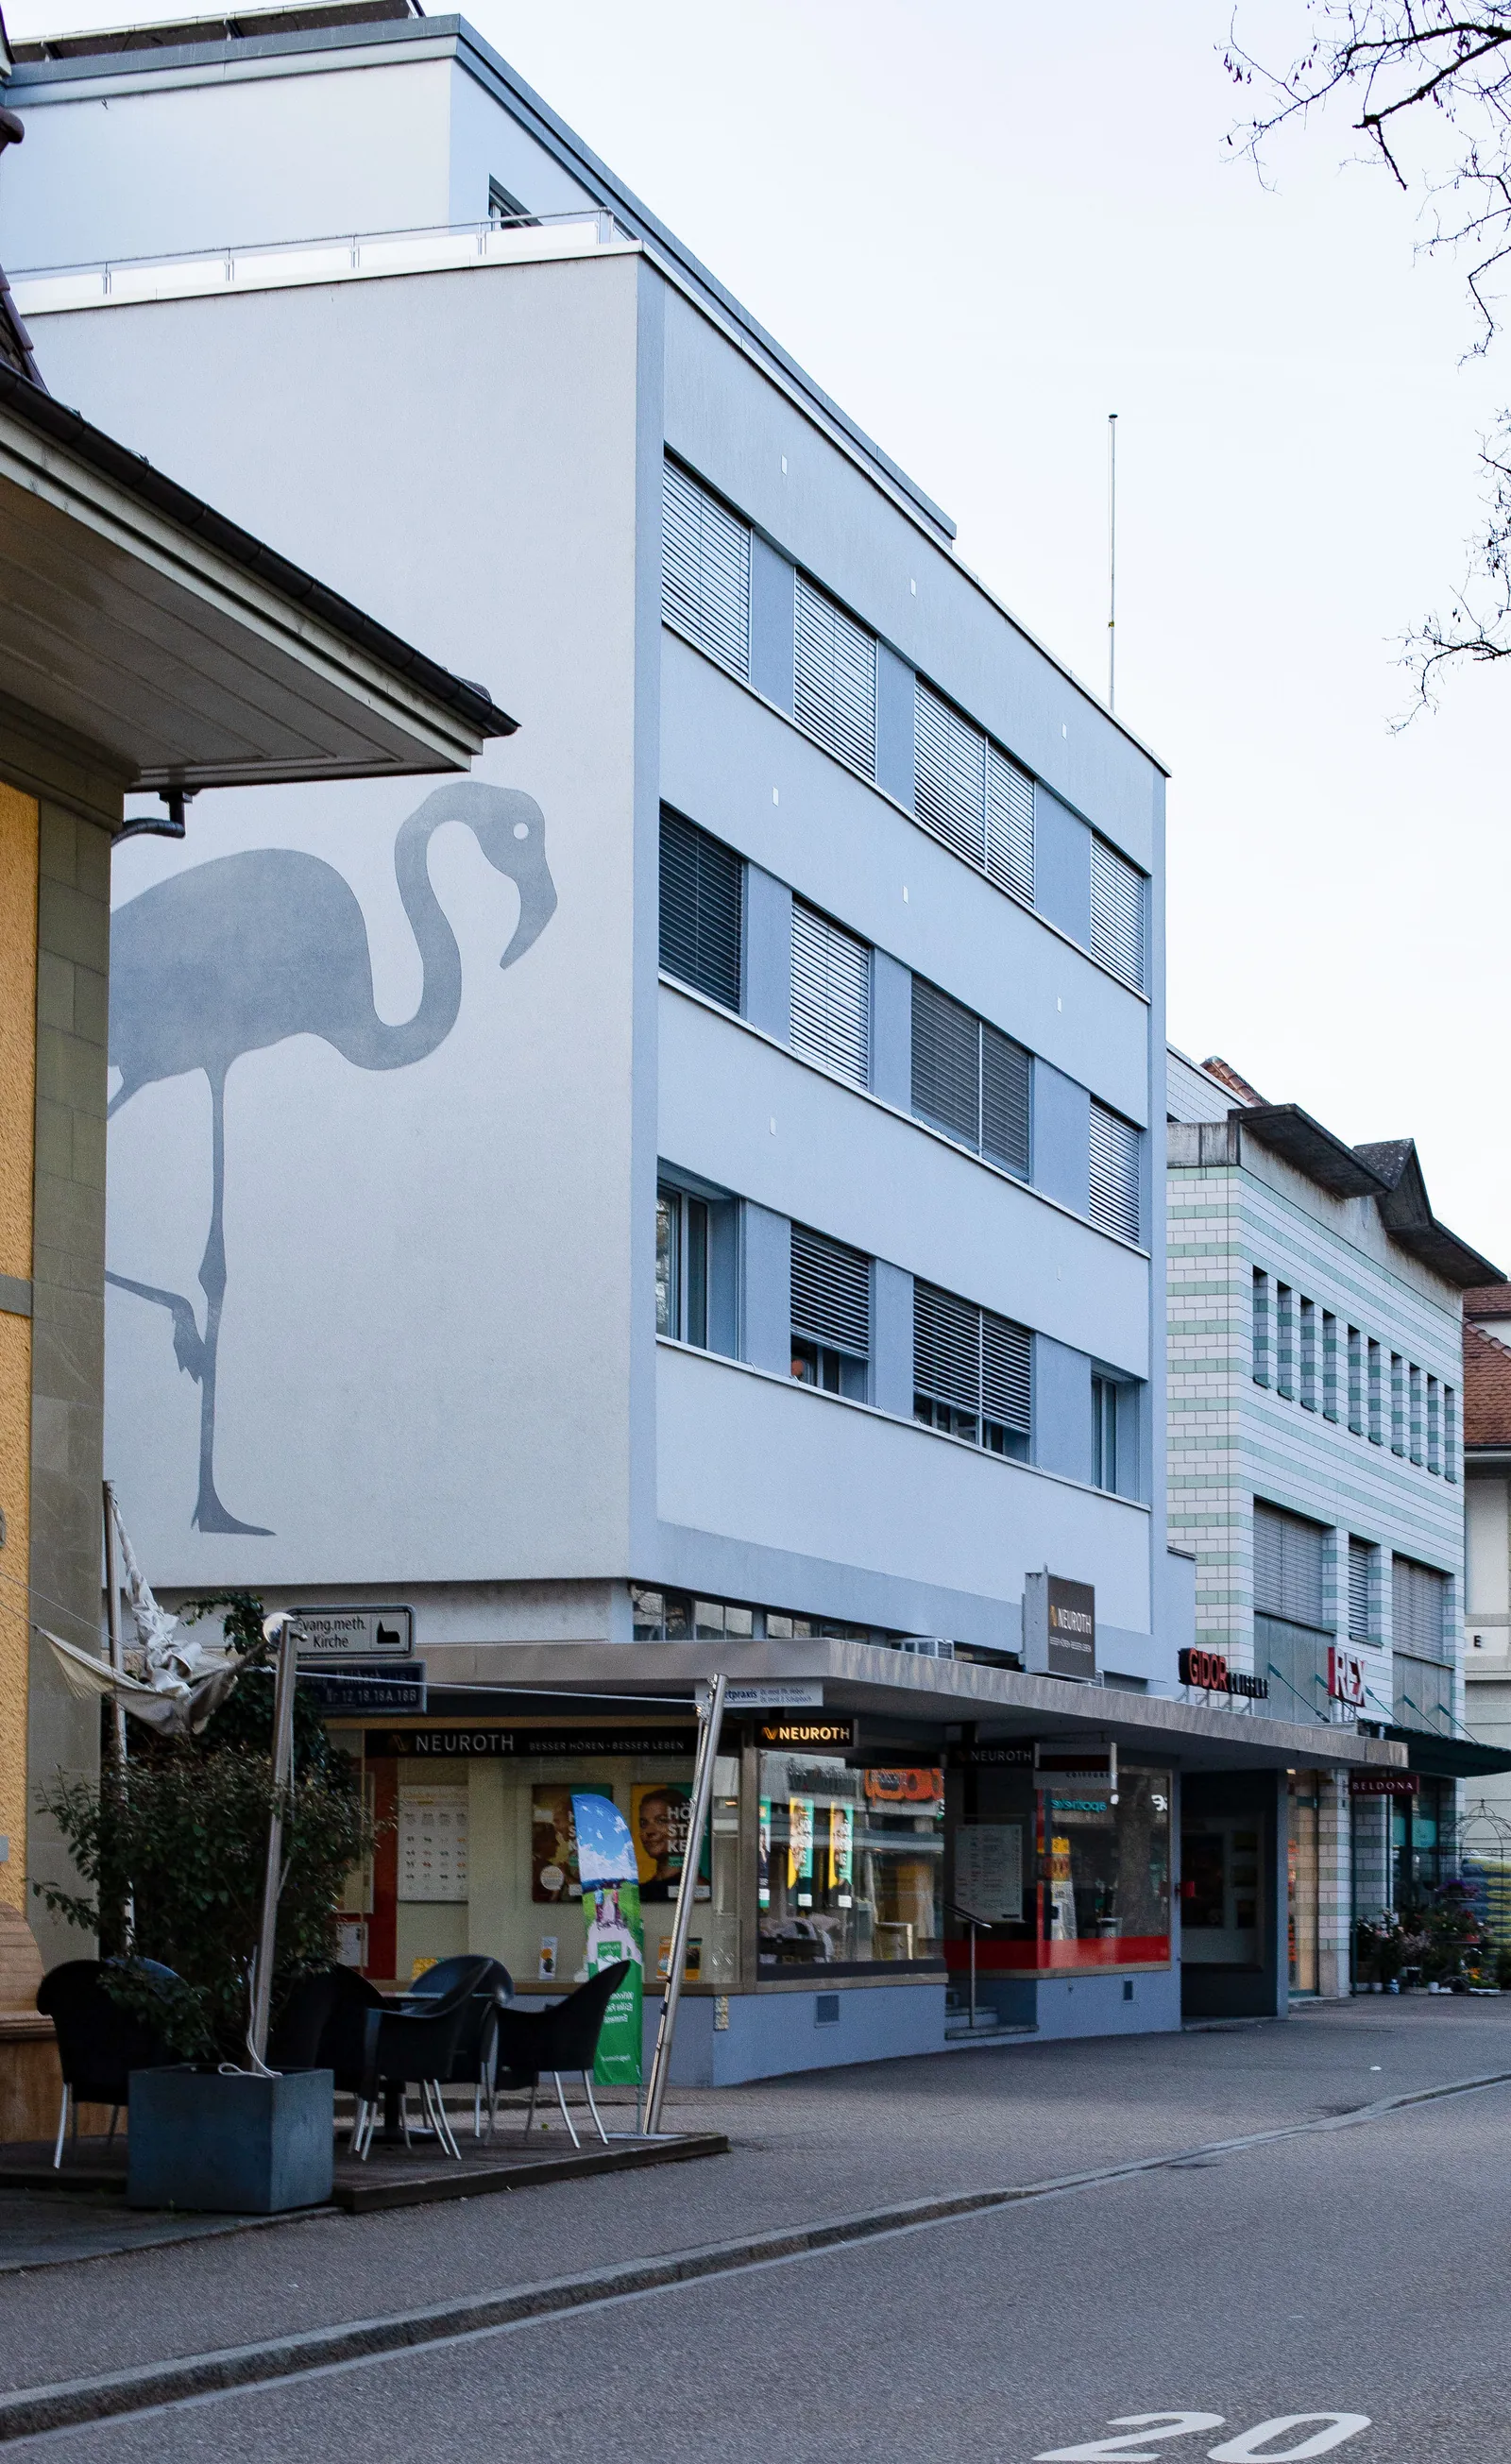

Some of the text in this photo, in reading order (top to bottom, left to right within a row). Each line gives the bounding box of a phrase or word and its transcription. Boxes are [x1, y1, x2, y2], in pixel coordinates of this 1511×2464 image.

[1058, 1607, 1092, 1635] NEUROTH
[313, 1633, 349, 1649] Kirche
[1189, 1647, 1228, 1691] GIDOR
[1333, 1648, 1367, 1707] REX
[779, 1726, 850, 1741] NEUROTH
[416, 1734, 685, 1752] NEUROTH BESSER HÖREN BESSER LEBEN
[971, 1750, 1032, 1761] NEUROTH
[1352, 1780, 1414, 1791] BELDONA
[1031, 2411, 1371, 2464] 20
